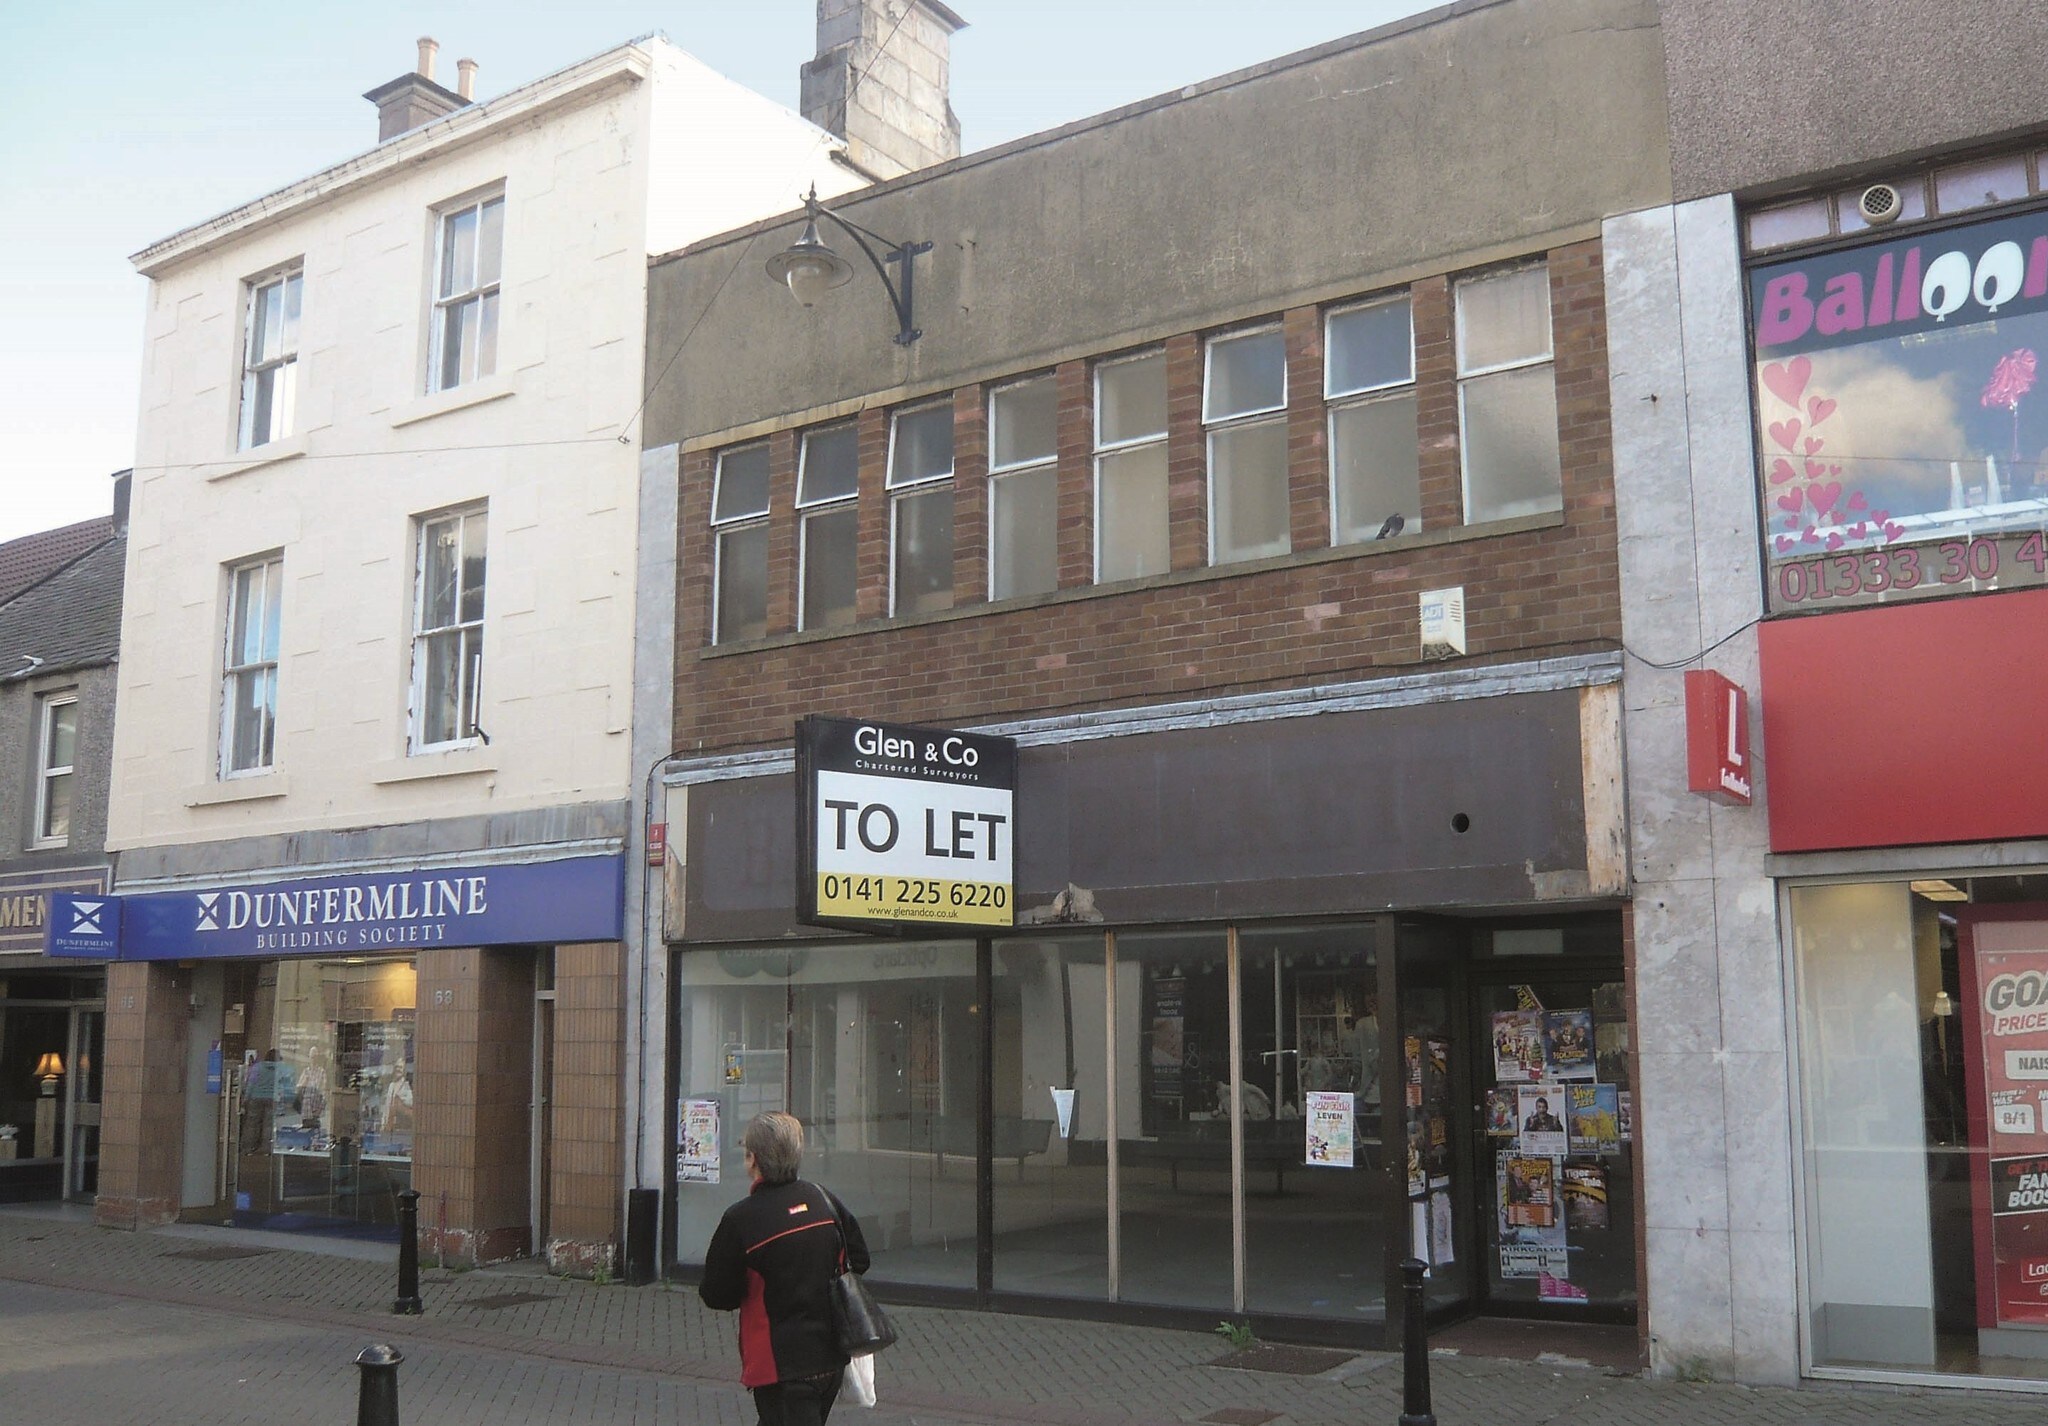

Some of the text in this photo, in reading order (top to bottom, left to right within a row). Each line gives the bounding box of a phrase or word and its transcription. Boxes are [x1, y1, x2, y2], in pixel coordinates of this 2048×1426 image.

[1779, 549, 1922, 603] 01333
[1940, 537, 1999, 584] 30
[854, 726, 979, 767] Glen & Co
[855, 759, 980, 781] Chartered Surveyors
[824, 799, 1007, 861] TO LET
[226, 876, 488, 930] DUNFERMLINE
[824, 875, 1006, 908] 0141 225 6220
[867, 905, 959, 919] www.glenandco.co.uk
[257, 923, 446, 949] BUILDING SOCIETY
[1317, 1112, 1343, 1120] LEVEN
